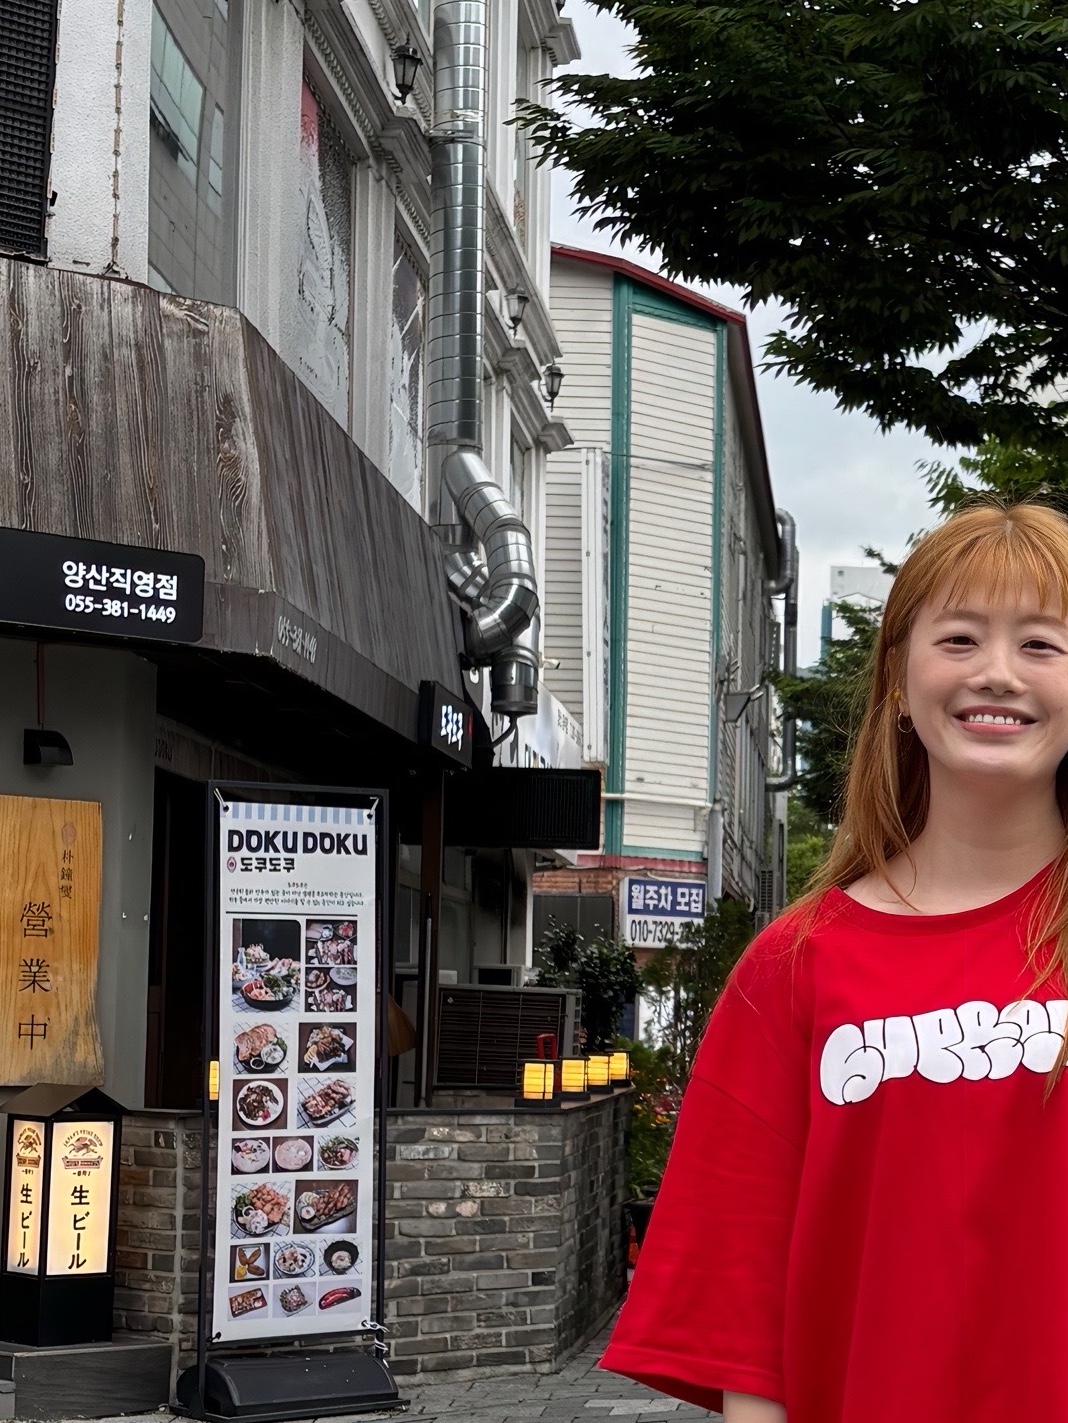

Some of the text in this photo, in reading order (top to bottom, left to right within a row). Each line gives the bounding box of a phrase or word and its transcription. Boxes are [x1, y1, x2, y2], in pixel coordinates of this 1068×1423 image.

[62, 561, 178, 601] 양산직영점
[65, 594, 176, 624] 055-381-1449
[228, 829, 368, 856] DOKU DOKU
[240, 857, 295, 873] 도쿠도쿠
[631, 884, 703, 913] 월주차 모집
[18, 901, 52, 1050] 營業中
[17, 1183, 33, 1268] 生ビール
[68, 1184, 91, 1270] 生ビール
